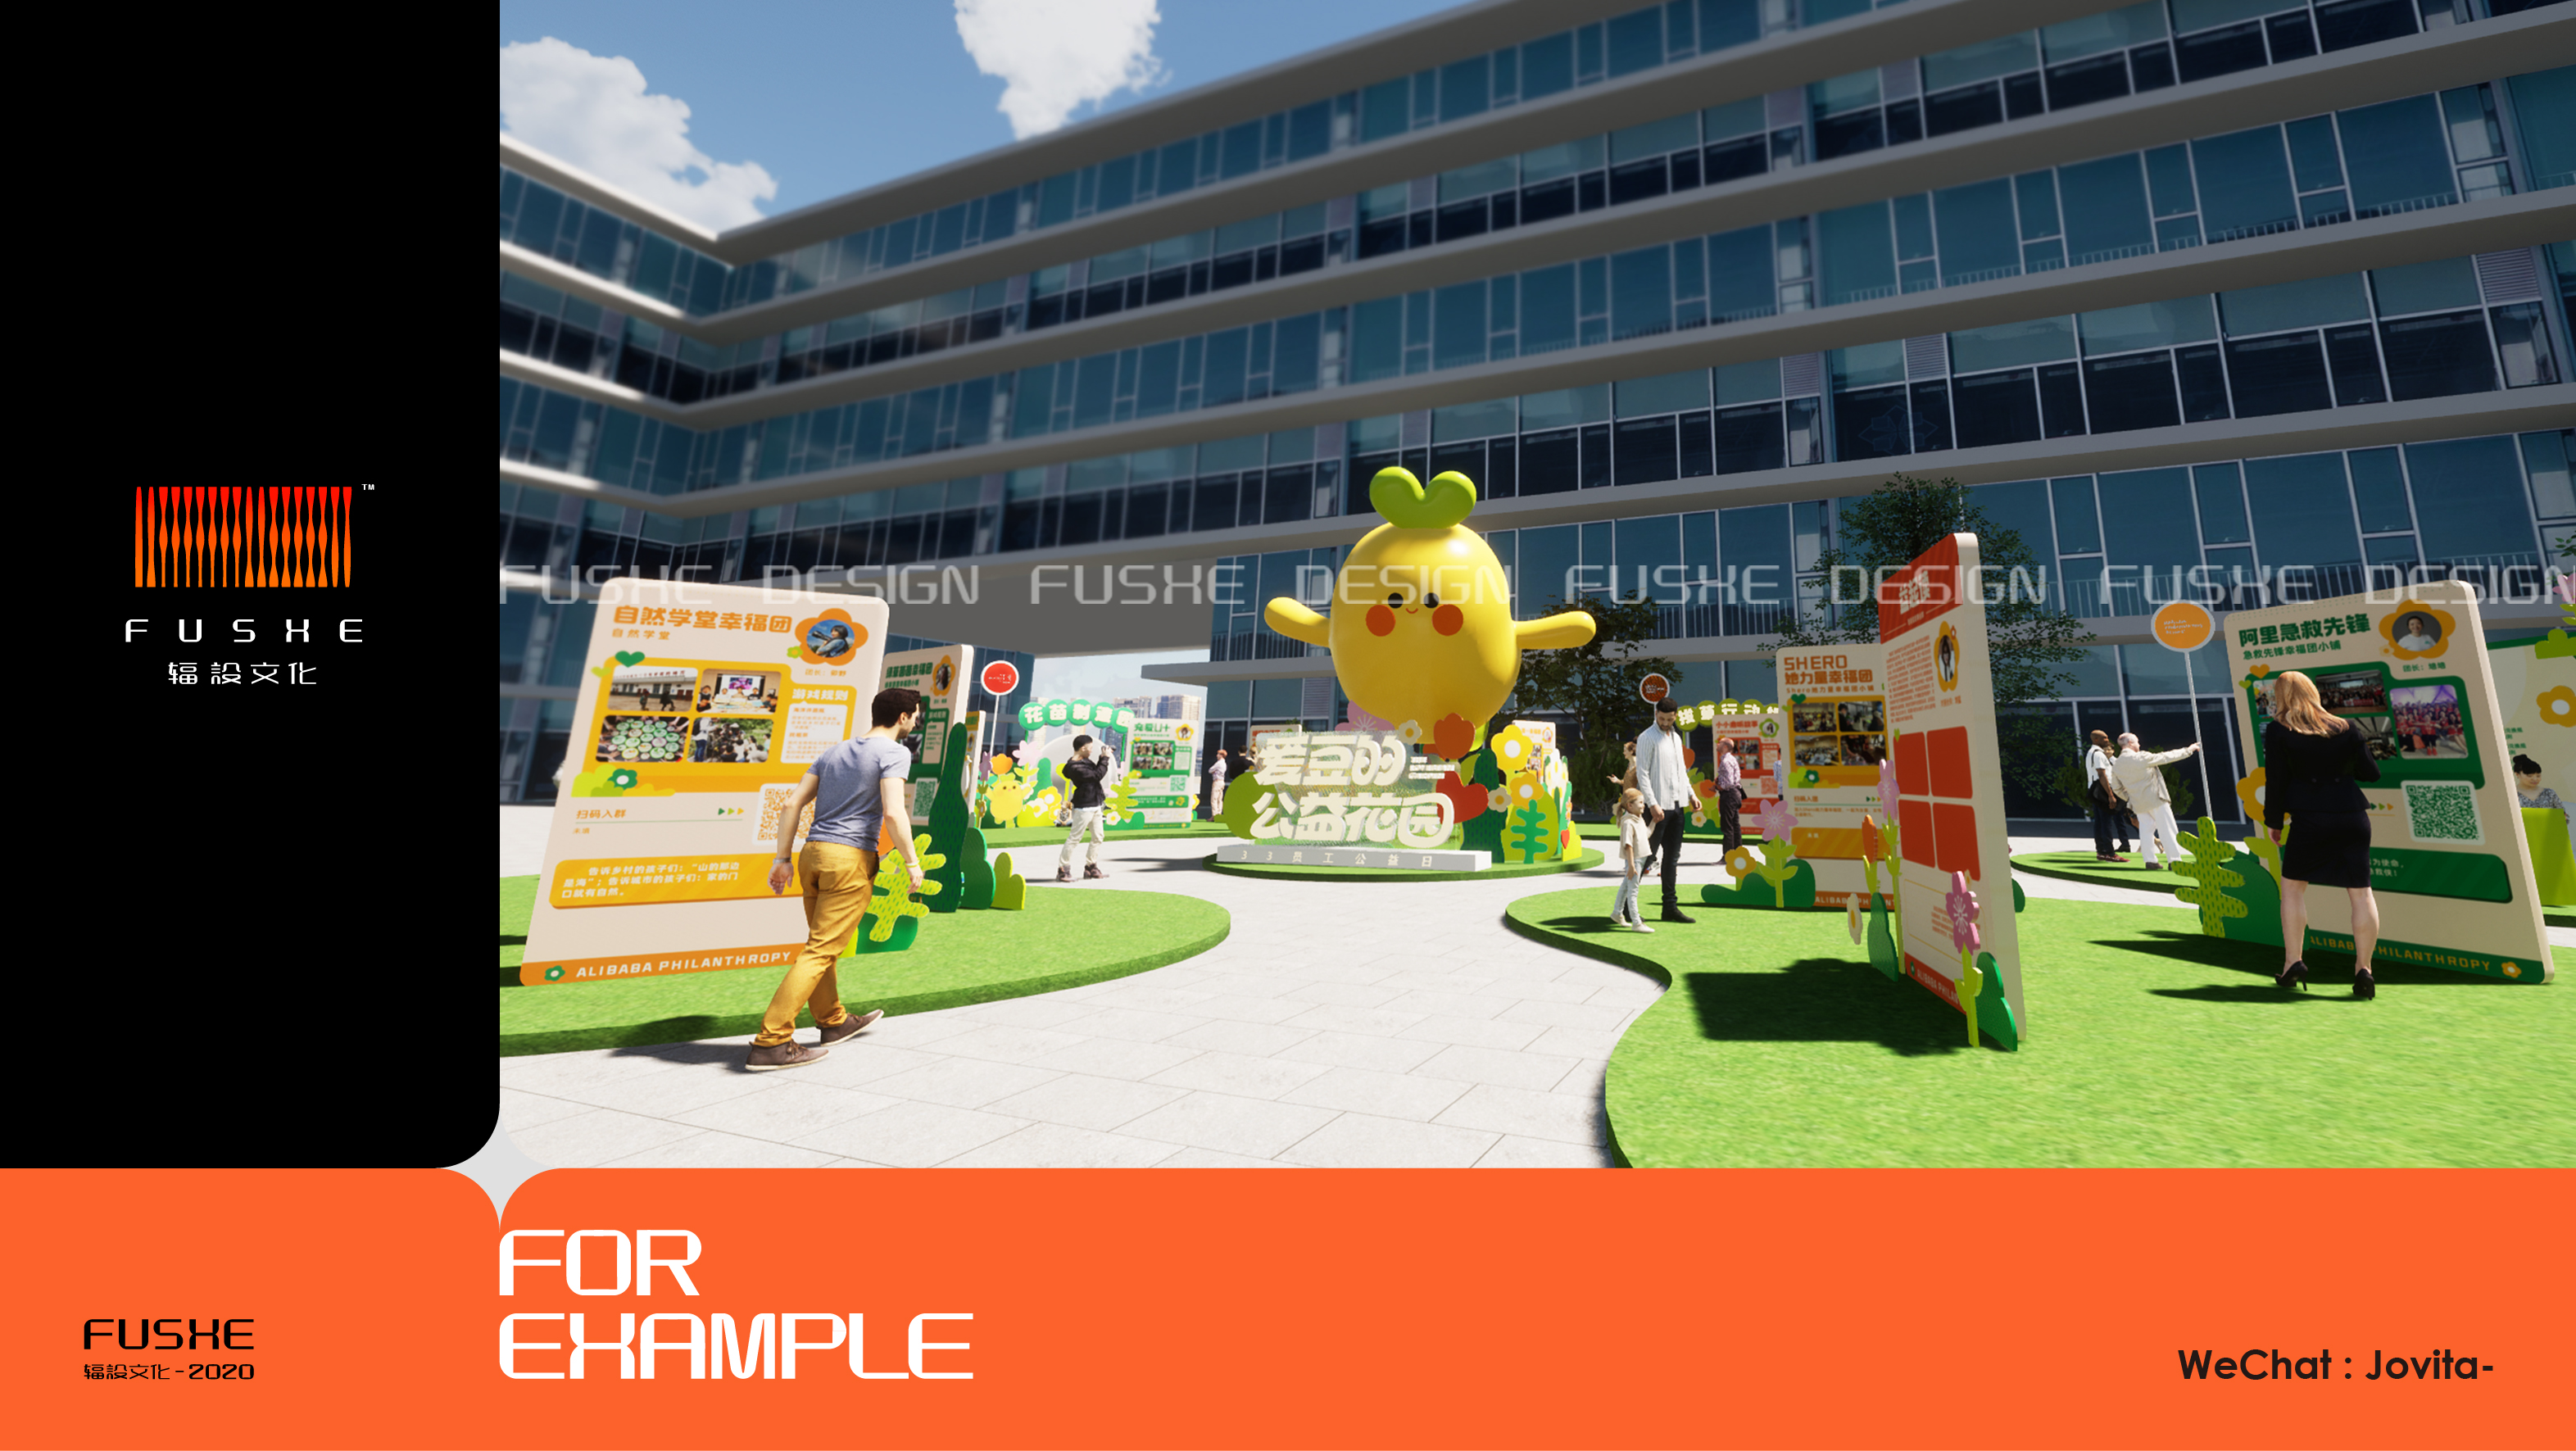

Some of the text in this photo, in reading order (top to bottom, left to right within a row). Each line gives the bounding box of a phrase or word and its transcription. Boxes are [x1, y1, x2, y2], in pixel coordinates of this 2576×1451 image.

[613, 605, 792, 633] 自然学堂幸福团
[612, 628, 670, 641] 自然学堂
[2238, 613, 2371, 647] 阿里急救先锋
[2243, 640, 2342, 660] 急救先锋幸福团小铺
[1784, 655, 1848, 670] SHERO
[1785, 669, 1873, 685] 她力量幸福团
[791, 688, 849, 701] 游戏规则
[1253, 734, 1407, 786] 爱豆的
[575, 809, 627, 819] 扫码入群
[1249, 791, 1455, 849] 公益花园
[2369, 858, 2404, 868] 为使命，
[1816, 896, 1847, 905] ALIBAB
[2310, 936, 2355, 951] ALIBAB
[576, 951, 791, 977] ALIBABA PHILANTHROPY
